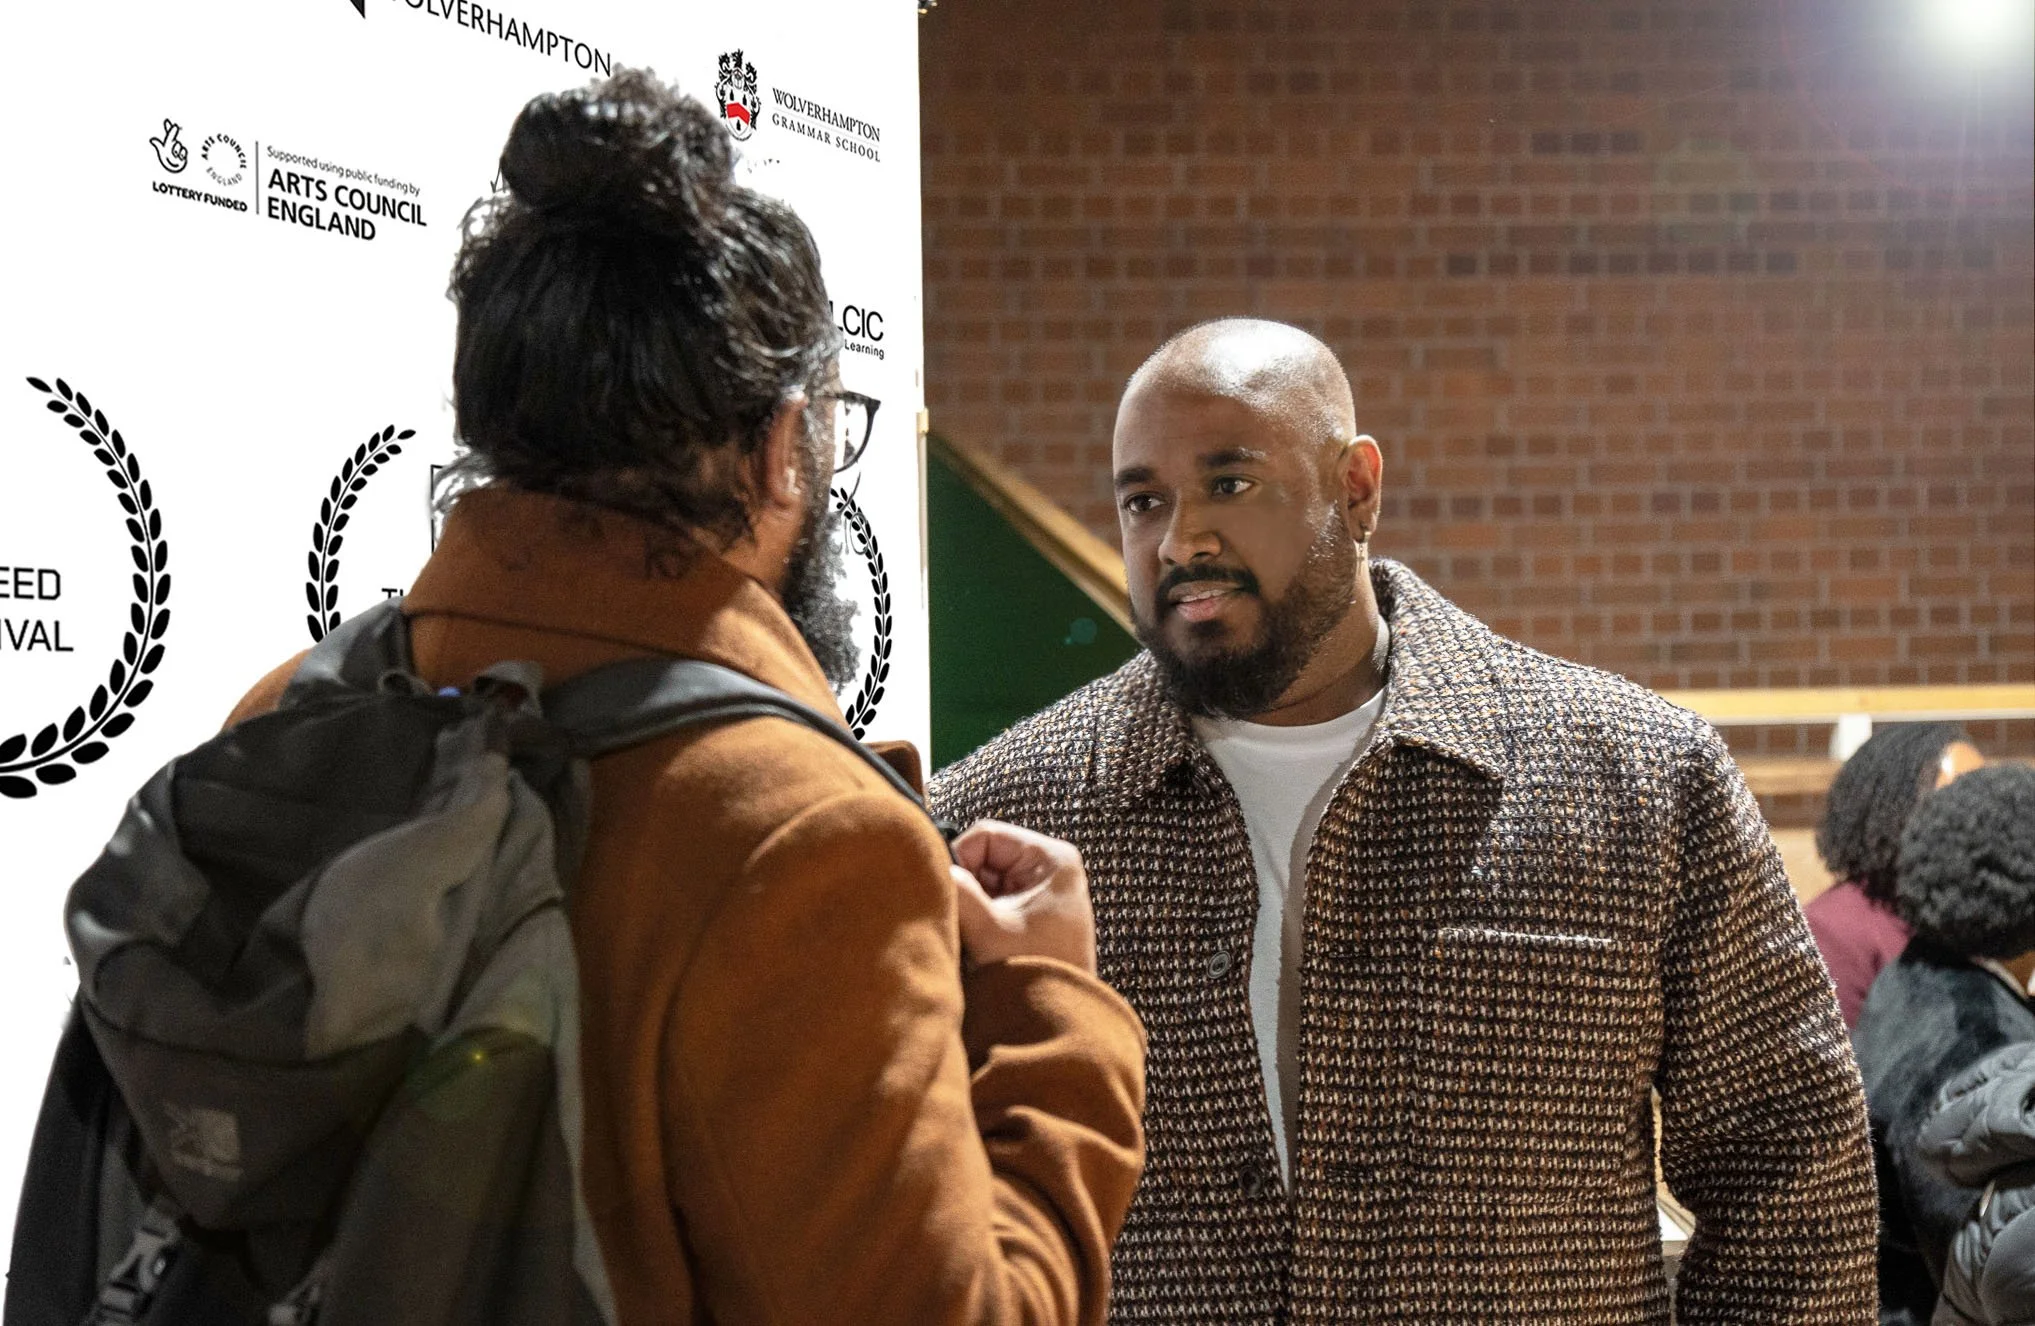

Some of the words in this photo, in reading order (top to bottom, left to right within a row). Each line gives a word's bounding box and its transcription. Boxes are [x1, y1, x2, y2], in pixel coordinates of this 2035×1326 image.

[392, 0, 611, 77] LVERHAMPTON
[772, 87, 881, 142] WOLVERHAMPTON
[772, 113, 831, 144] GRAMMAR
[835, 136, 881, 162] SCHOOL
[216, 133, 247, 169] COUNCIL
[266, 145, 318, 169] Supported
[318, 160, 344, 178] using
[345, 168, 373, 184] public
[374, 172, 408, 196] funding
[409, 182, 421, 198] by
[152, 180, 203, 202] LOTTERY
[203, 192, 248, 212] FUNDED
[268, 168, 327, 202] ARTS
[335, 185, 427, 226] COUNCIL
[268, 195, 376, 240] ENGLAND
[844, 339, 885, 361] Learning
[0, 618, 74, 652] VAL
